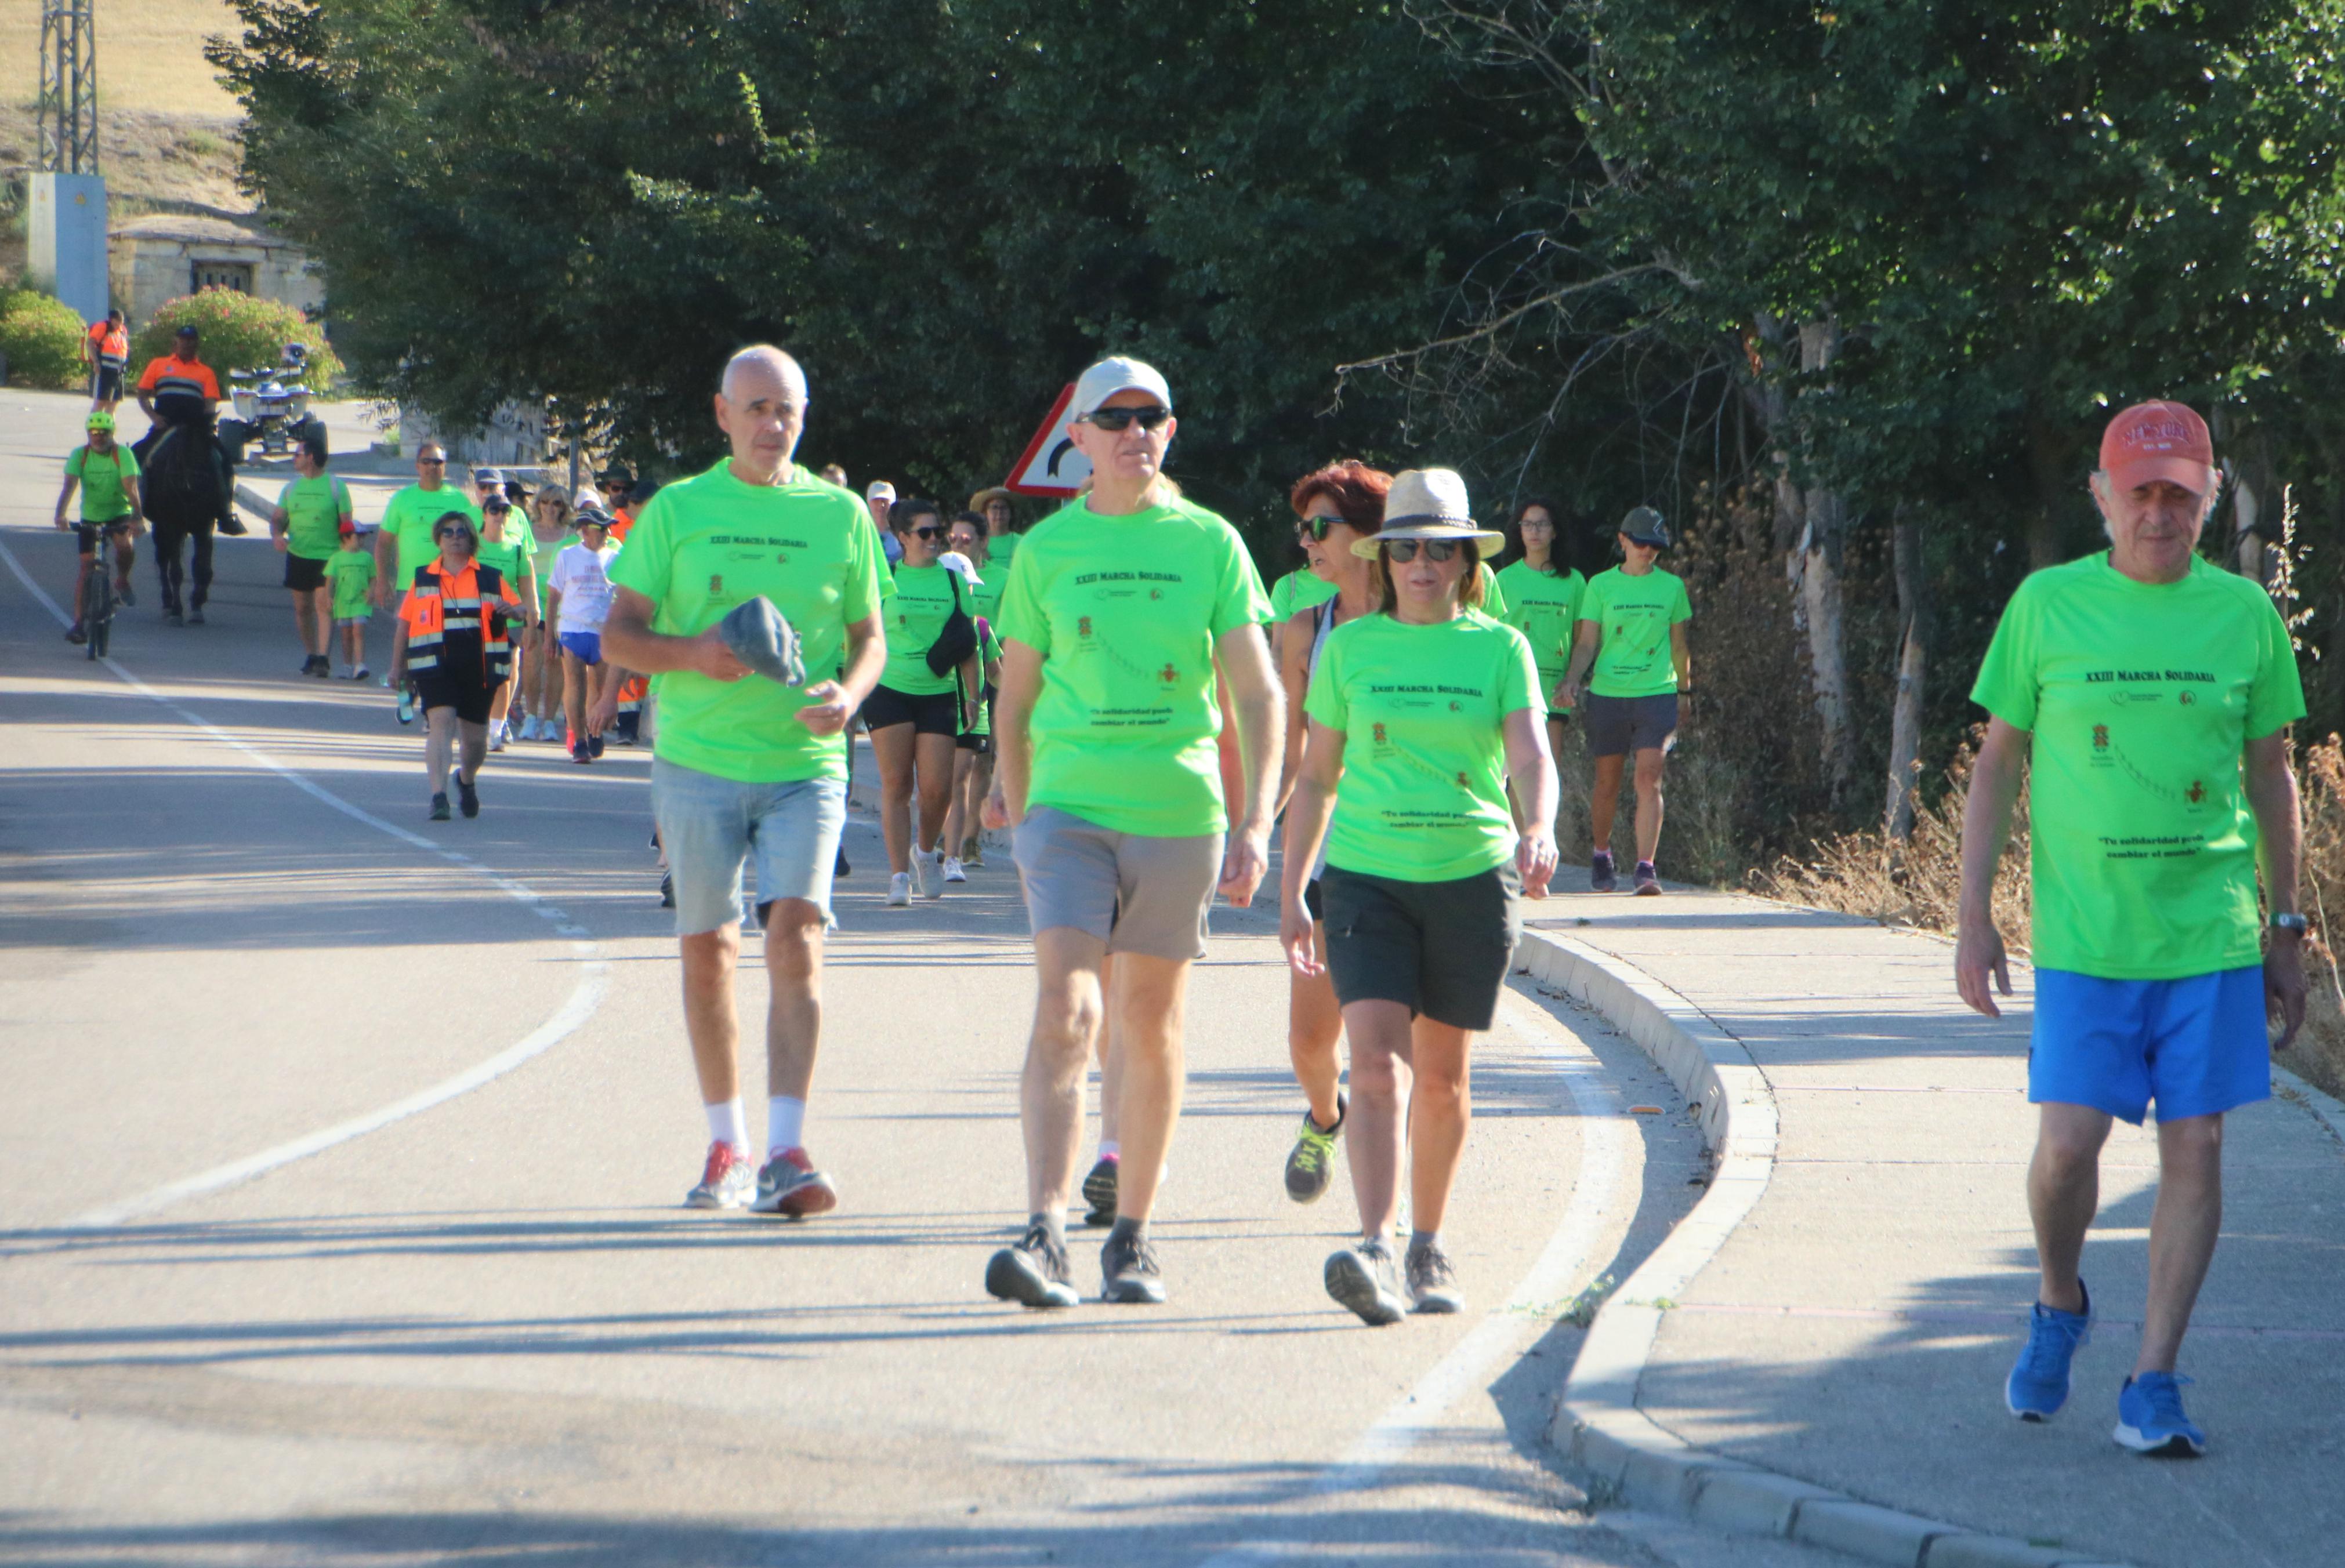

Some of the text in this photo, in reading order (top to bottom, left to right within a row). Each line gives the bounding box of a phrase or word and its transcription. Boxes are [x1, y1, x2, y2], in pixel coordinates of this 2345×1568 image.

[733, 536, 766, 545] MARCHA
[768, 537, 808, 549] SOLIDARIA
[1100, 572, 1136, 580] MARCHA
[1138, 571, 1182, 583] SOLIDARIA
[2086, 669, 2215, 683] XXIII MARCHA SOLIDARIA
[1397, 685, 1434, 693] MARCHA
[1437, 685, 1483, 698] SOLIDARIA
[2120, 836, 2179, 845] solidaridad
[2107, 850, 2148, 858] cambiar
